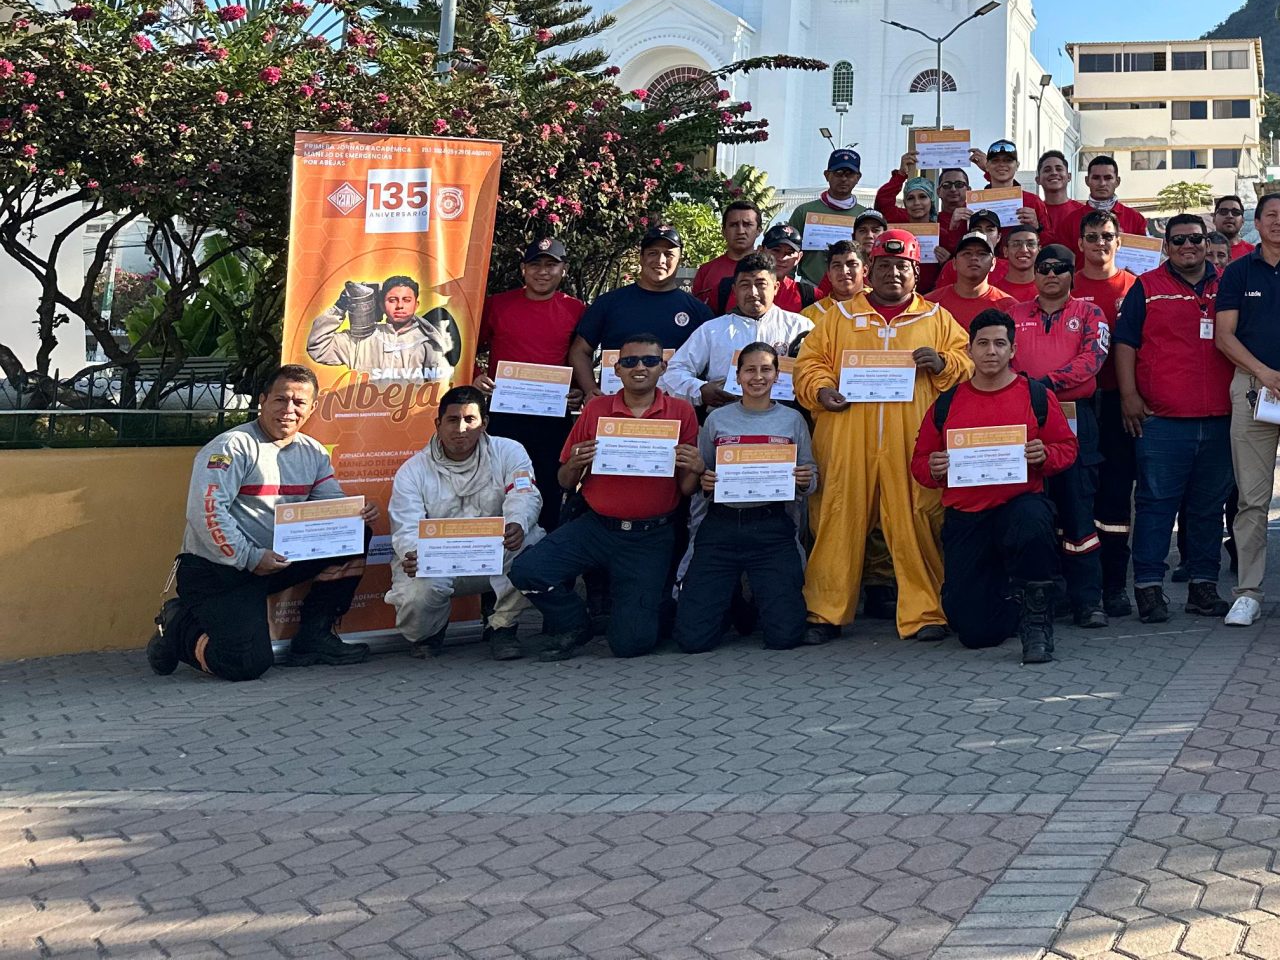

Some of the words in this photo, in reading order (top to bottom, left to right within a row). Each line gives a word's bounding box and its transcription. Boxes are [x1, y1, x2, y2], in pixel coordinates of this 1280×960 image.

[369, 181, 428, 210] 135
[319, 370, 454, 423] Abeja
[357, 468, 390, 478] ATAQUE
[204, 484, 235, 558] FUEGO
